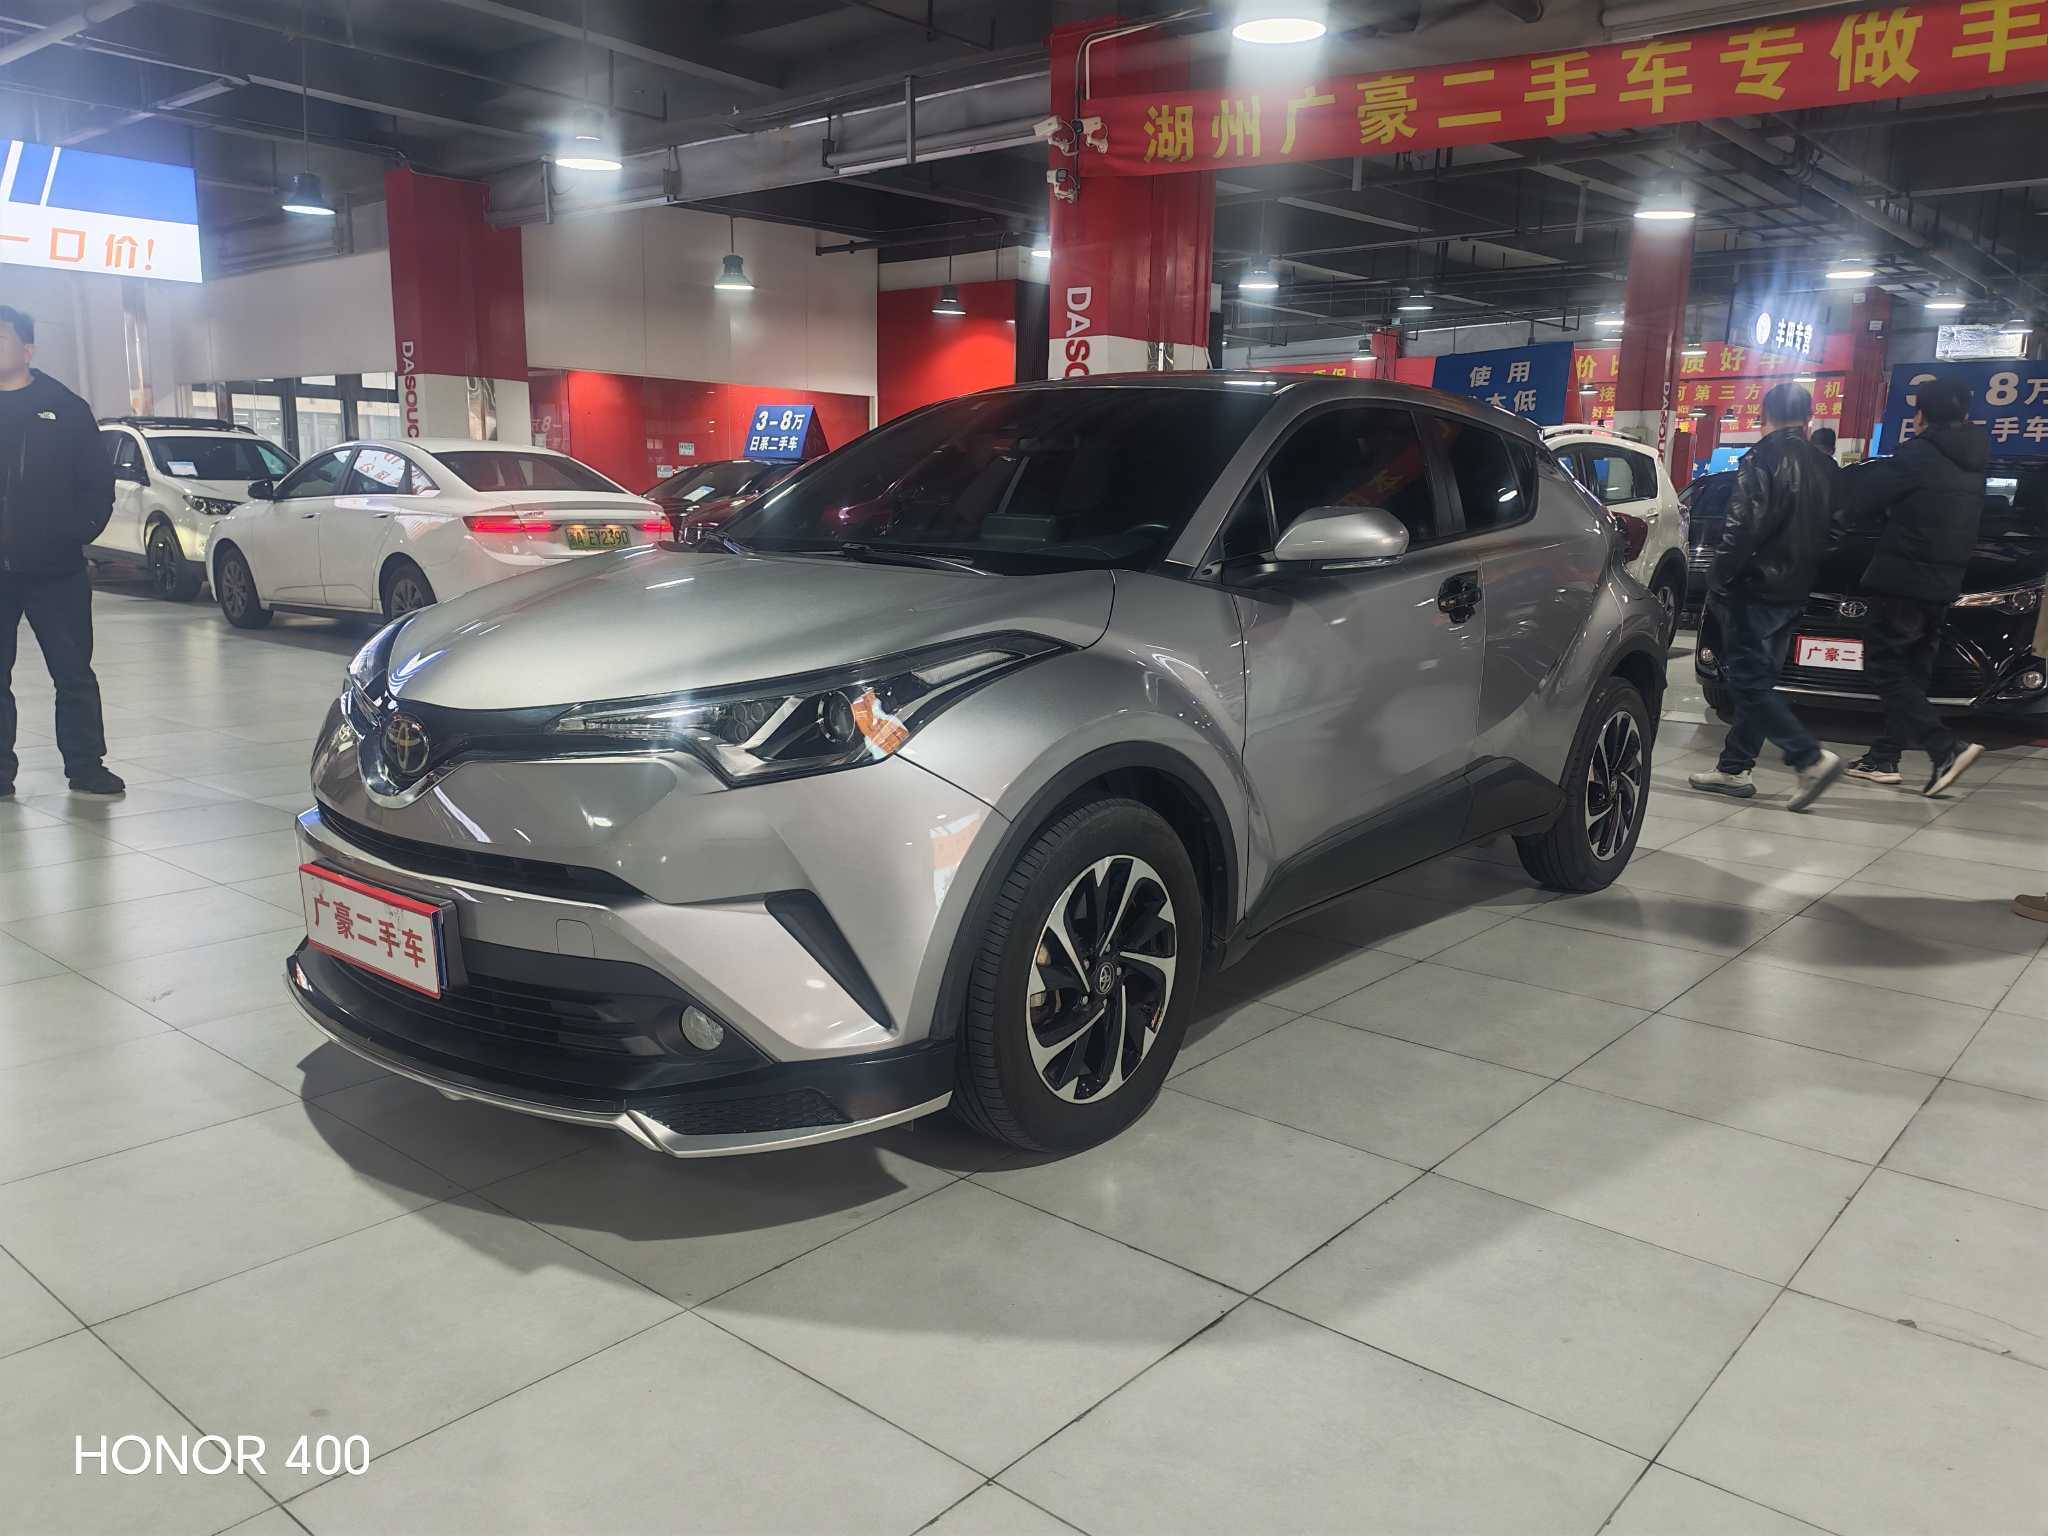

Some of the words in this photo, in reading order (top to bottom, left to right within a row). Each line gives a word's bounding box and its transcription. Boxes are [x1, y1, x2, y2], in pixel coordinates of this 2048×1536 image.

[1144, 0, 2048, 162] 湖州广豪二手车专做丰
[1469, 361, 1531, 388] 使用
[756, 410, 805, 431] 3-8万
[749, 436, 799, 452] 日系二手车
[1806, 646, 1864, 662] 广豪二
[313, 892, 426, 968] 广豪二手车
